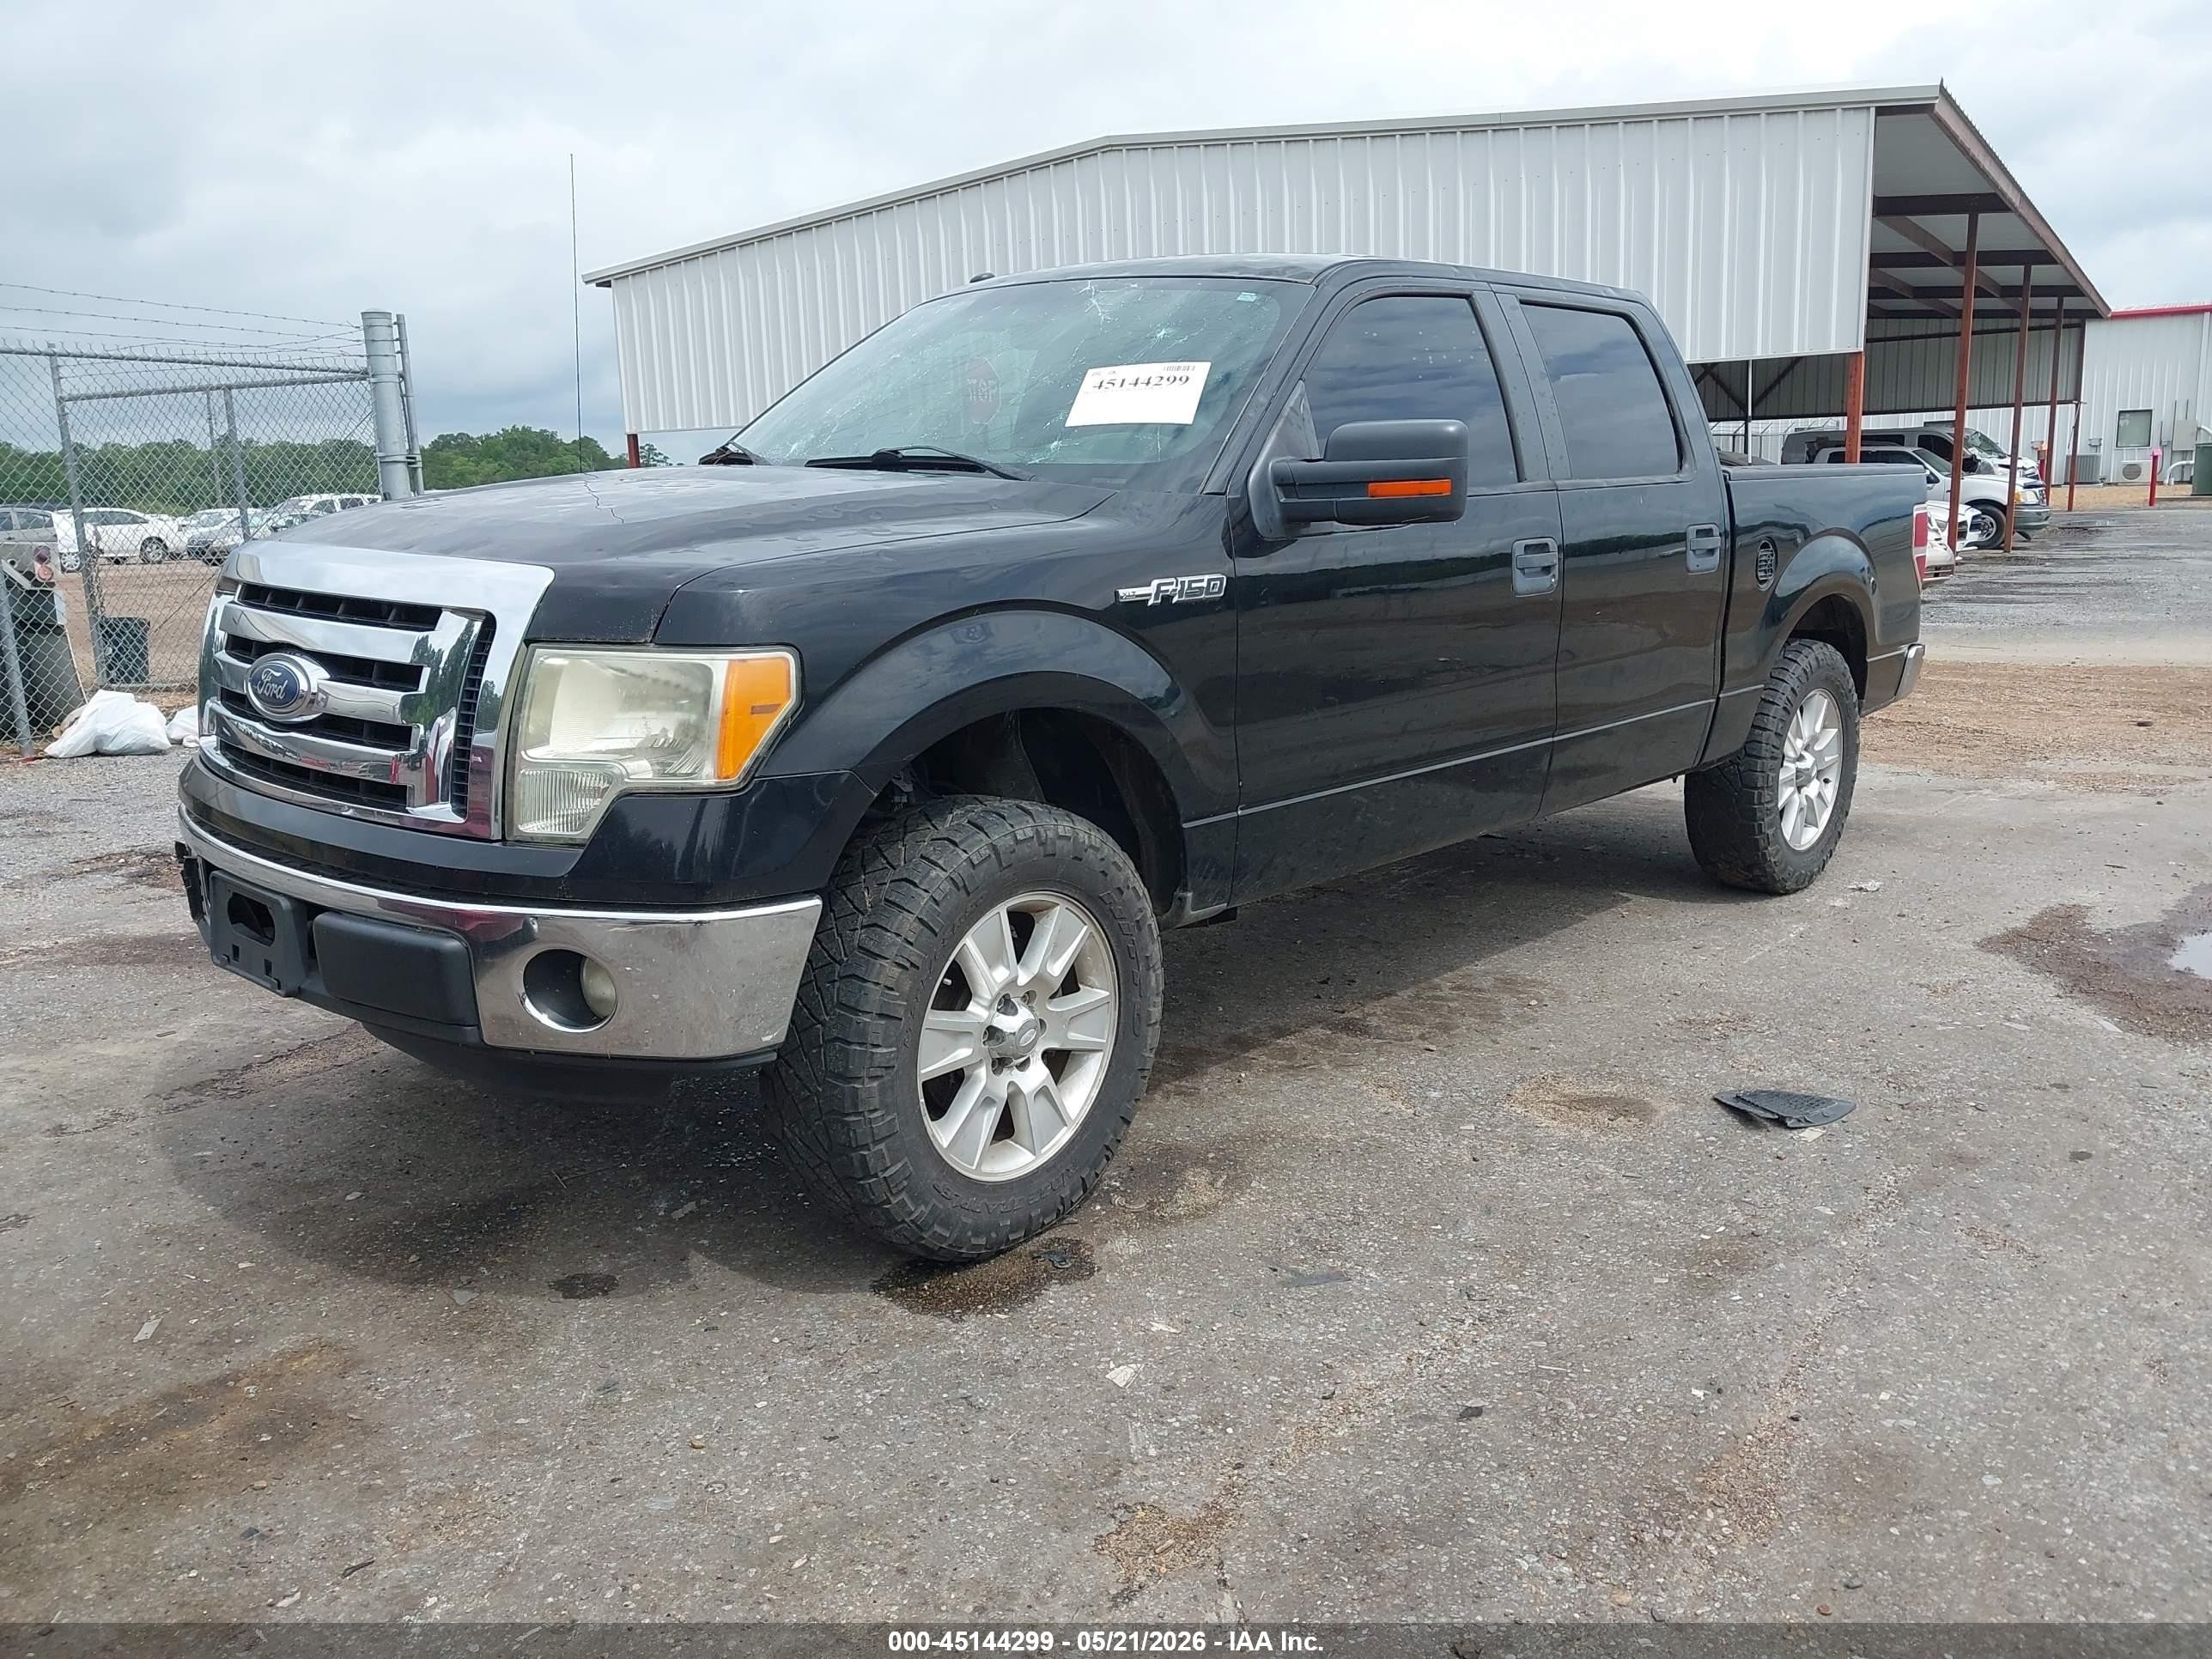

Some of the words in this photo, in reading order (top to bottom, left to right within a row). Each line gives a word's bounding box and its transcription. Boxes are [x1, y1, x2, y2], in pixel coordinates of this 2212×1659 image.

[1091, 374, 1191, 391] 45144299
[1148, 574, 1227, 606] F-150
[254, 668, 289, 700] Ford
